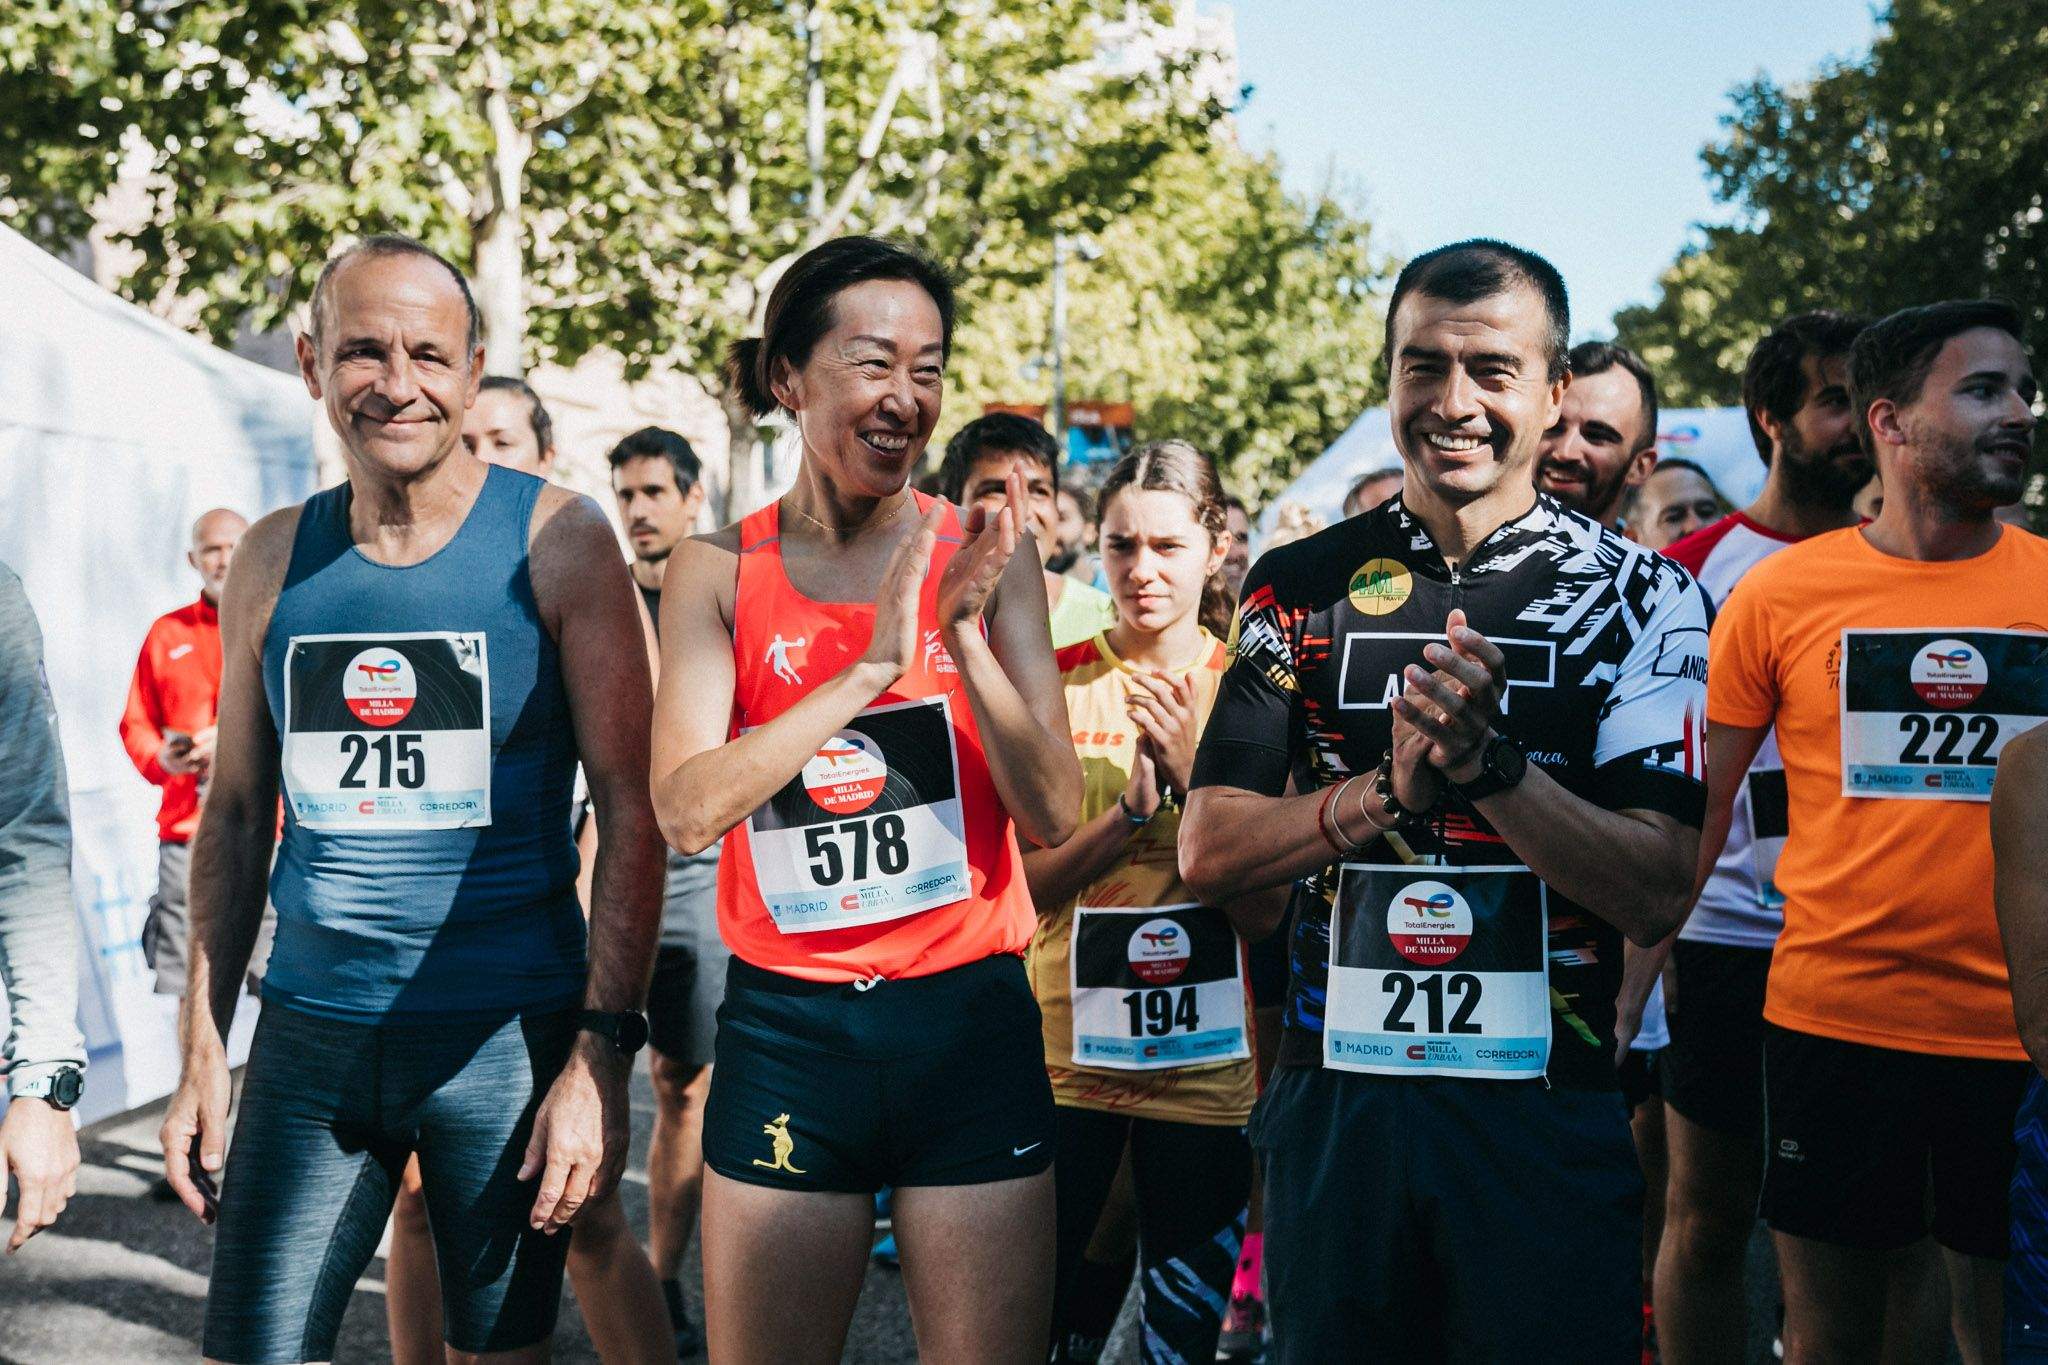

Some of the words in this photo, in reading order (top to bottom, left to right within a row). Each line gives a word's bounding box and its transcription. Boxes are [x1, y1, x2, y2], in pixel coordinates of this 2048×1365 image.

[1926, 672, 1972, 680] TotalEnergies
[373, 708, 404, 716] MADRID
[1899, 714, 1999, 766] 222
[339, 734, 425, 789] 215
[819, 767, 870, 780] TotalEnergies
[1868, 774, 1913, 785] MADRID
[832, 784, 862, 795] MILLA
[824, 796, 836, 806] DE
[838, 790, 875, 803] MADRID
[307, 802, 347, 813] MADRID
[804, 814, 909, 887] 578
[786, 901, 828, 915] MADRID
[1404, 921, 1455, 930] TotalEnergies
[1416, 937, 1445, 945] MILLA
[1405, 946, 1418, 954] DE
[1420, 946, 1456, 954] MADRID
[1382, 972, 1482, 1034] 212
[1123, 986, 1199, 1037] 194
[1096, 1044, 1134, 1055] MADRID
[1346, 1043, 1393, 1056] MADRID
[1428, 1045, 1457, 1053] MILLA
[1428, 1053, 1462, 1061] URBANA
